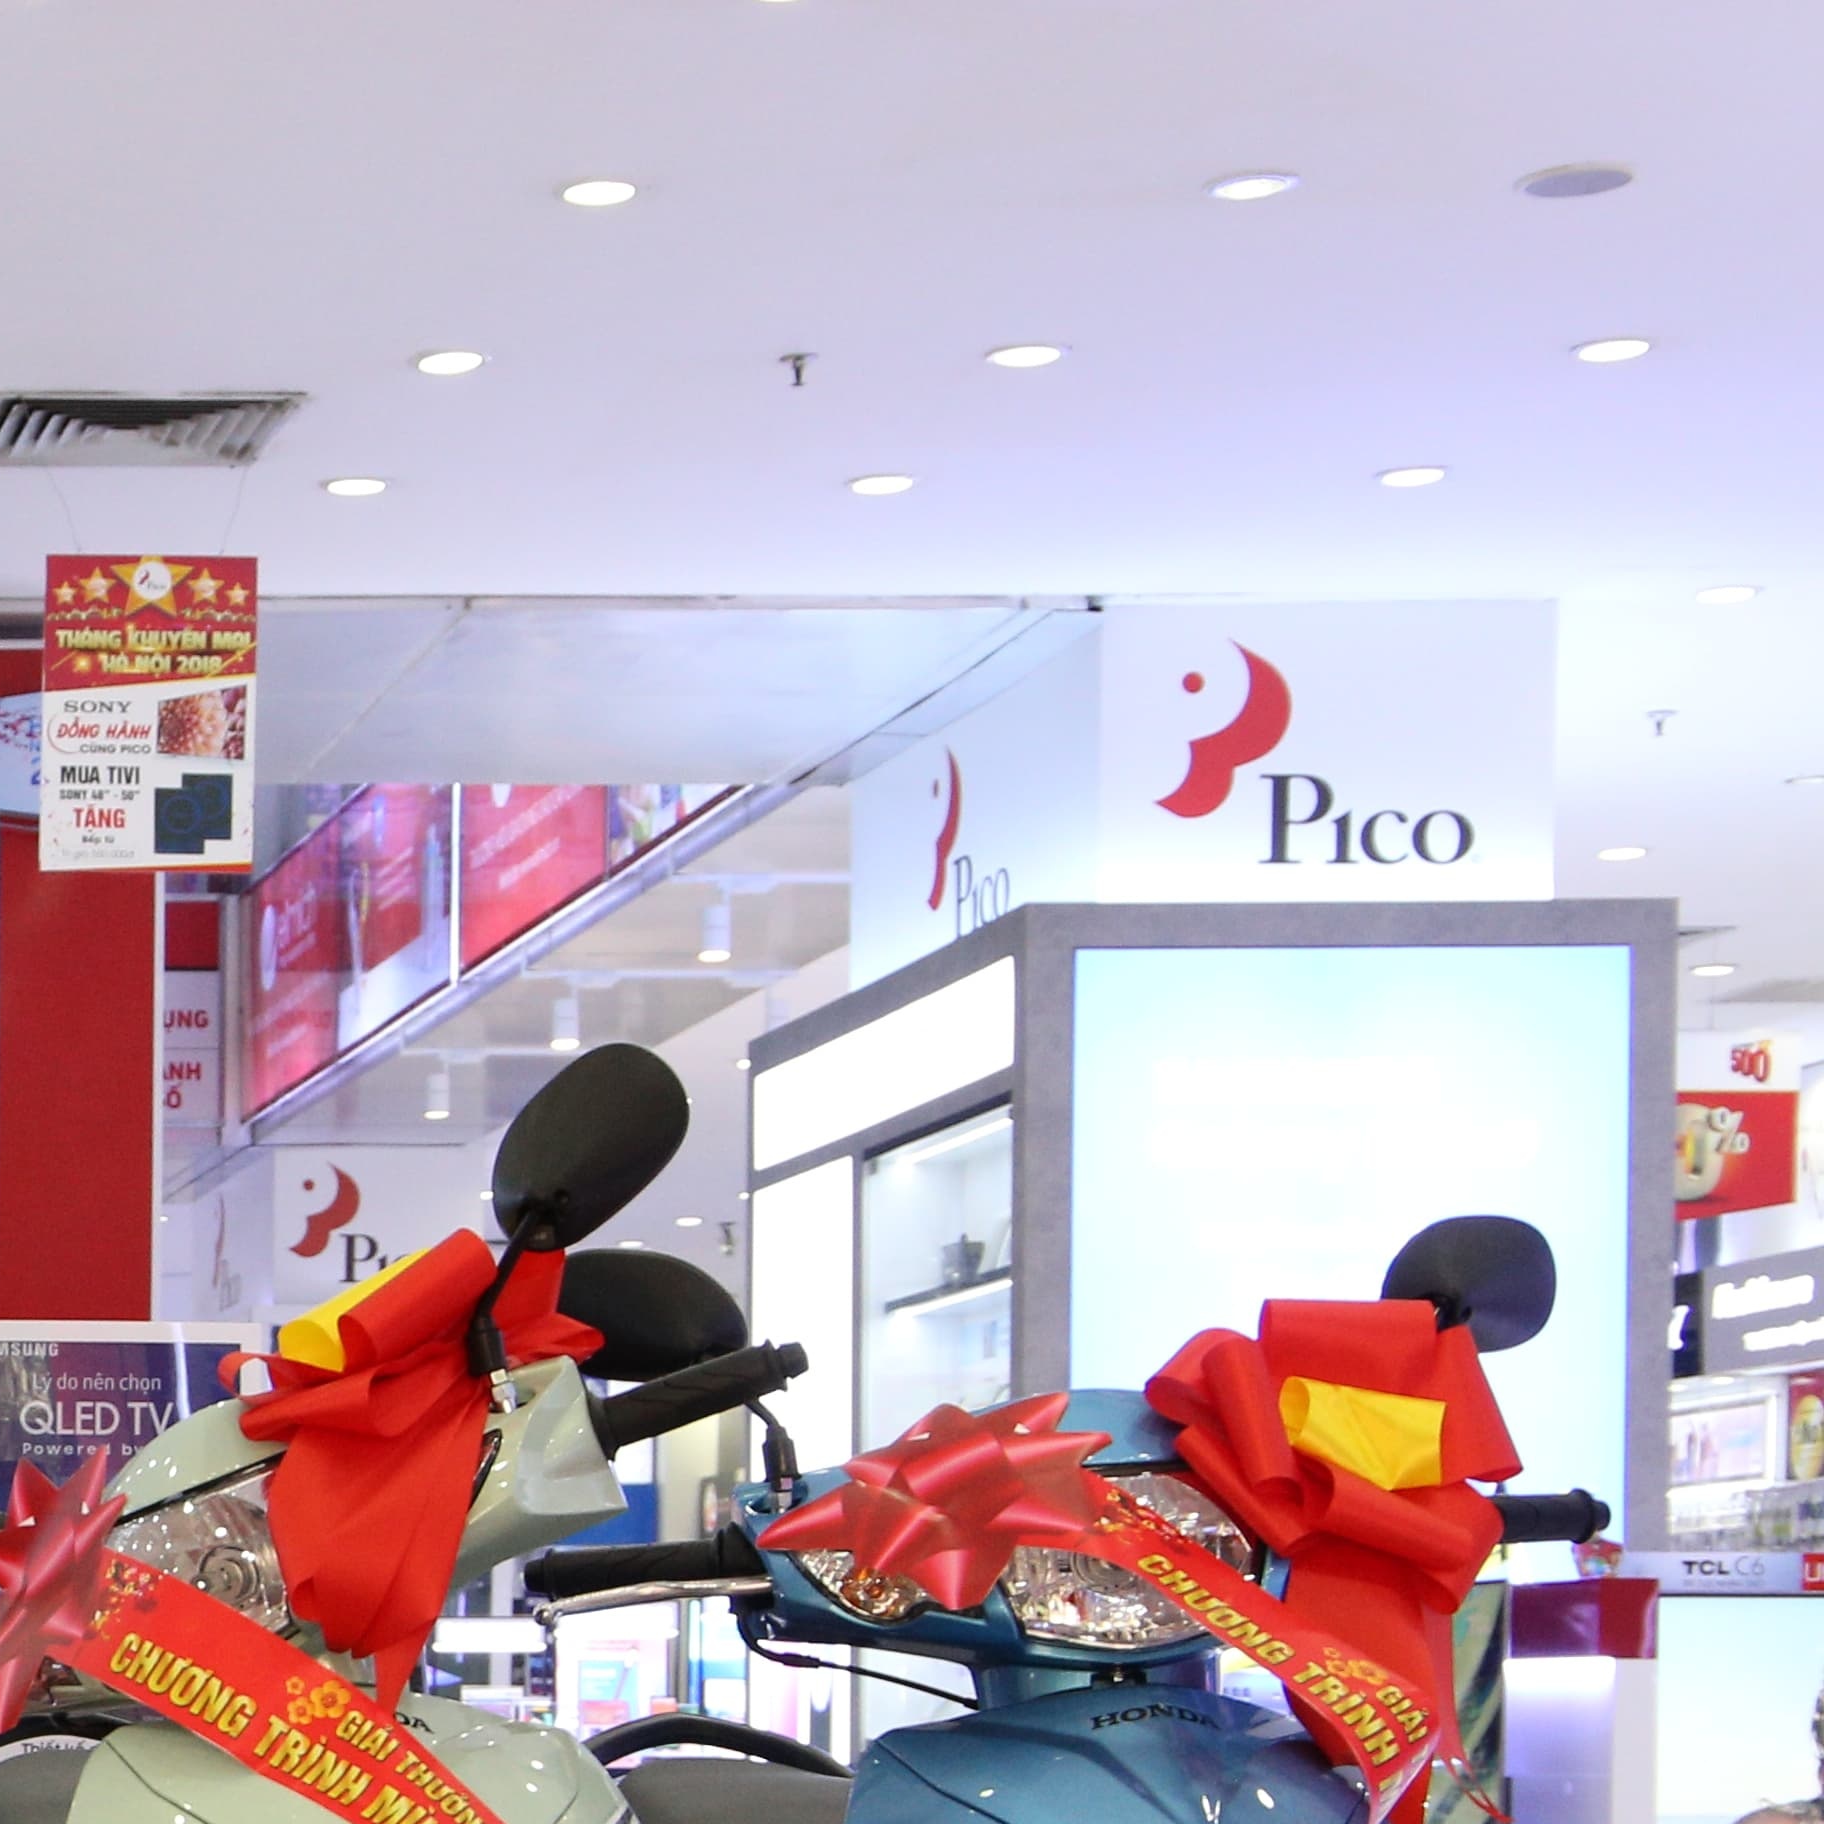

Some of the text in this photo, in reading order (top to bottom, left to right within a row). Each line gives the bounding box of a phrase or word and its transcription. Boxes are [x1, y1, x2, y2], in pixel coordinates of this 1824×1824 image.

[176, 655, 223, 673] 2018
[63, 700, 131, 713] SONY
[56, 718, 152, 740] ĐỒNG HÀNH
[79, 743, 152, 754] CÙNG PICO
[59, 766, 141, 785] MUA TIVI
[59, 789, 88, 801] SONY
[73, 803, 126, 833] TẶNG
[1257, 774, 1476, 864] Pico
[31, 1372, 162, 1396] Lý do nên chọn
[19, 1401, 174, 1437] QLED TV
[1681, 1555, 1766, 1577] TCL C6
[1137, 1552, 1297, 1666] CHƯƠNG
[1291, 1661, 1401, 1768] TRÌNH
[108, 1632, 258, 1738] CHƯƠNG
[251, 1714, 373, 1807] TRÌNH
[1090, 1704, 1223, 1732] HONDA
[1374, 1684, 1430, 1744] GIẢI
[335, 1709, 400, 1762] GIẢI
